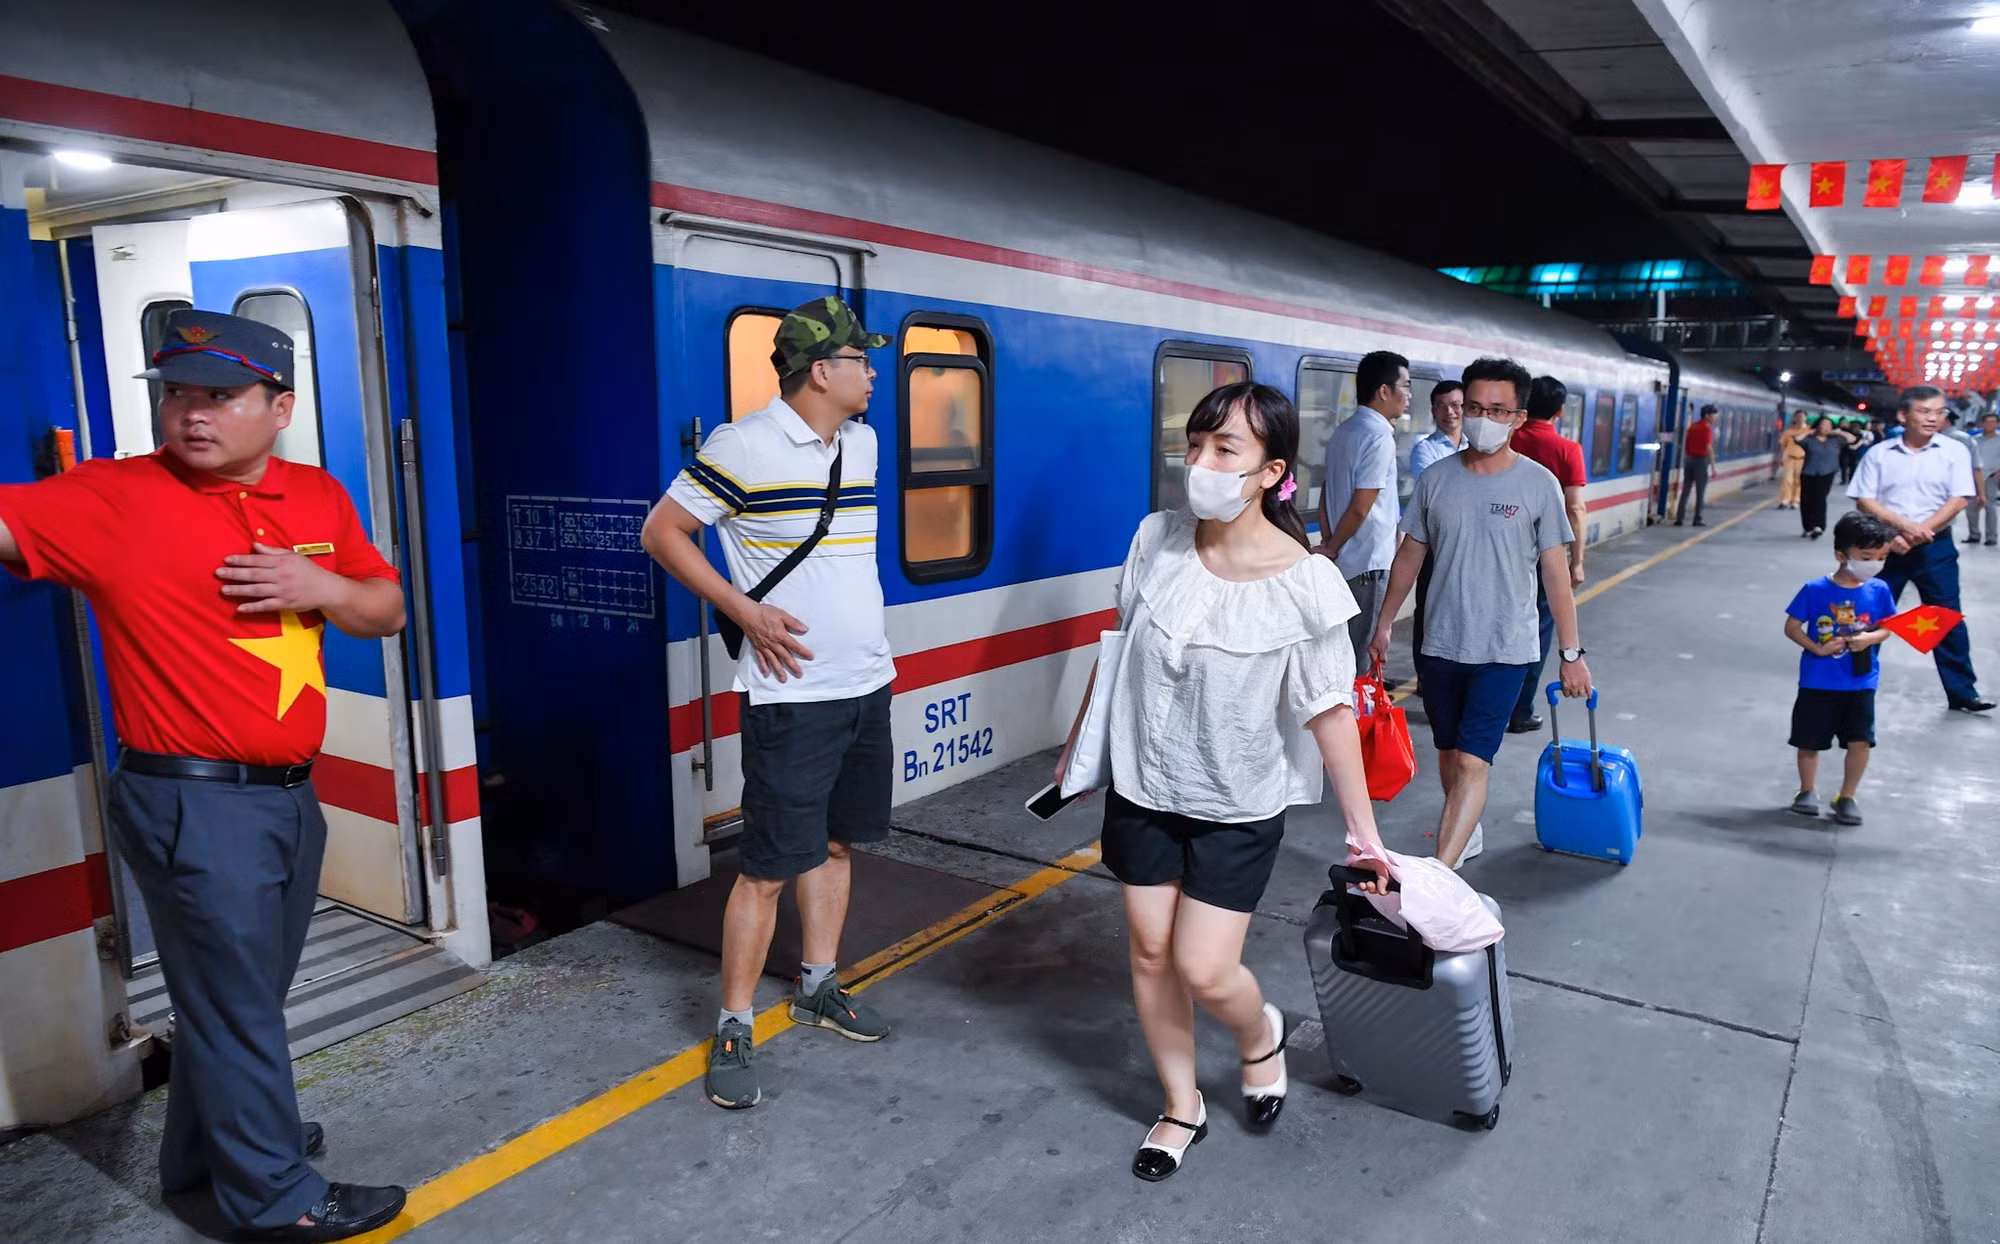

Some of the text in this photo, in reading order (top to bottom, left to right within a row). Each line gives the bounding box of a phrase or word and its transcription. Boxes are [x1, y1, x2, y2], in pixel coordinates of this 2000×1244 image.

[526, 530, 541, 547] 37
[599, 534, 611, 546] 25
[924, 692, 971, 733] SRT
[904, 727, 993, 782] Bn 21542
